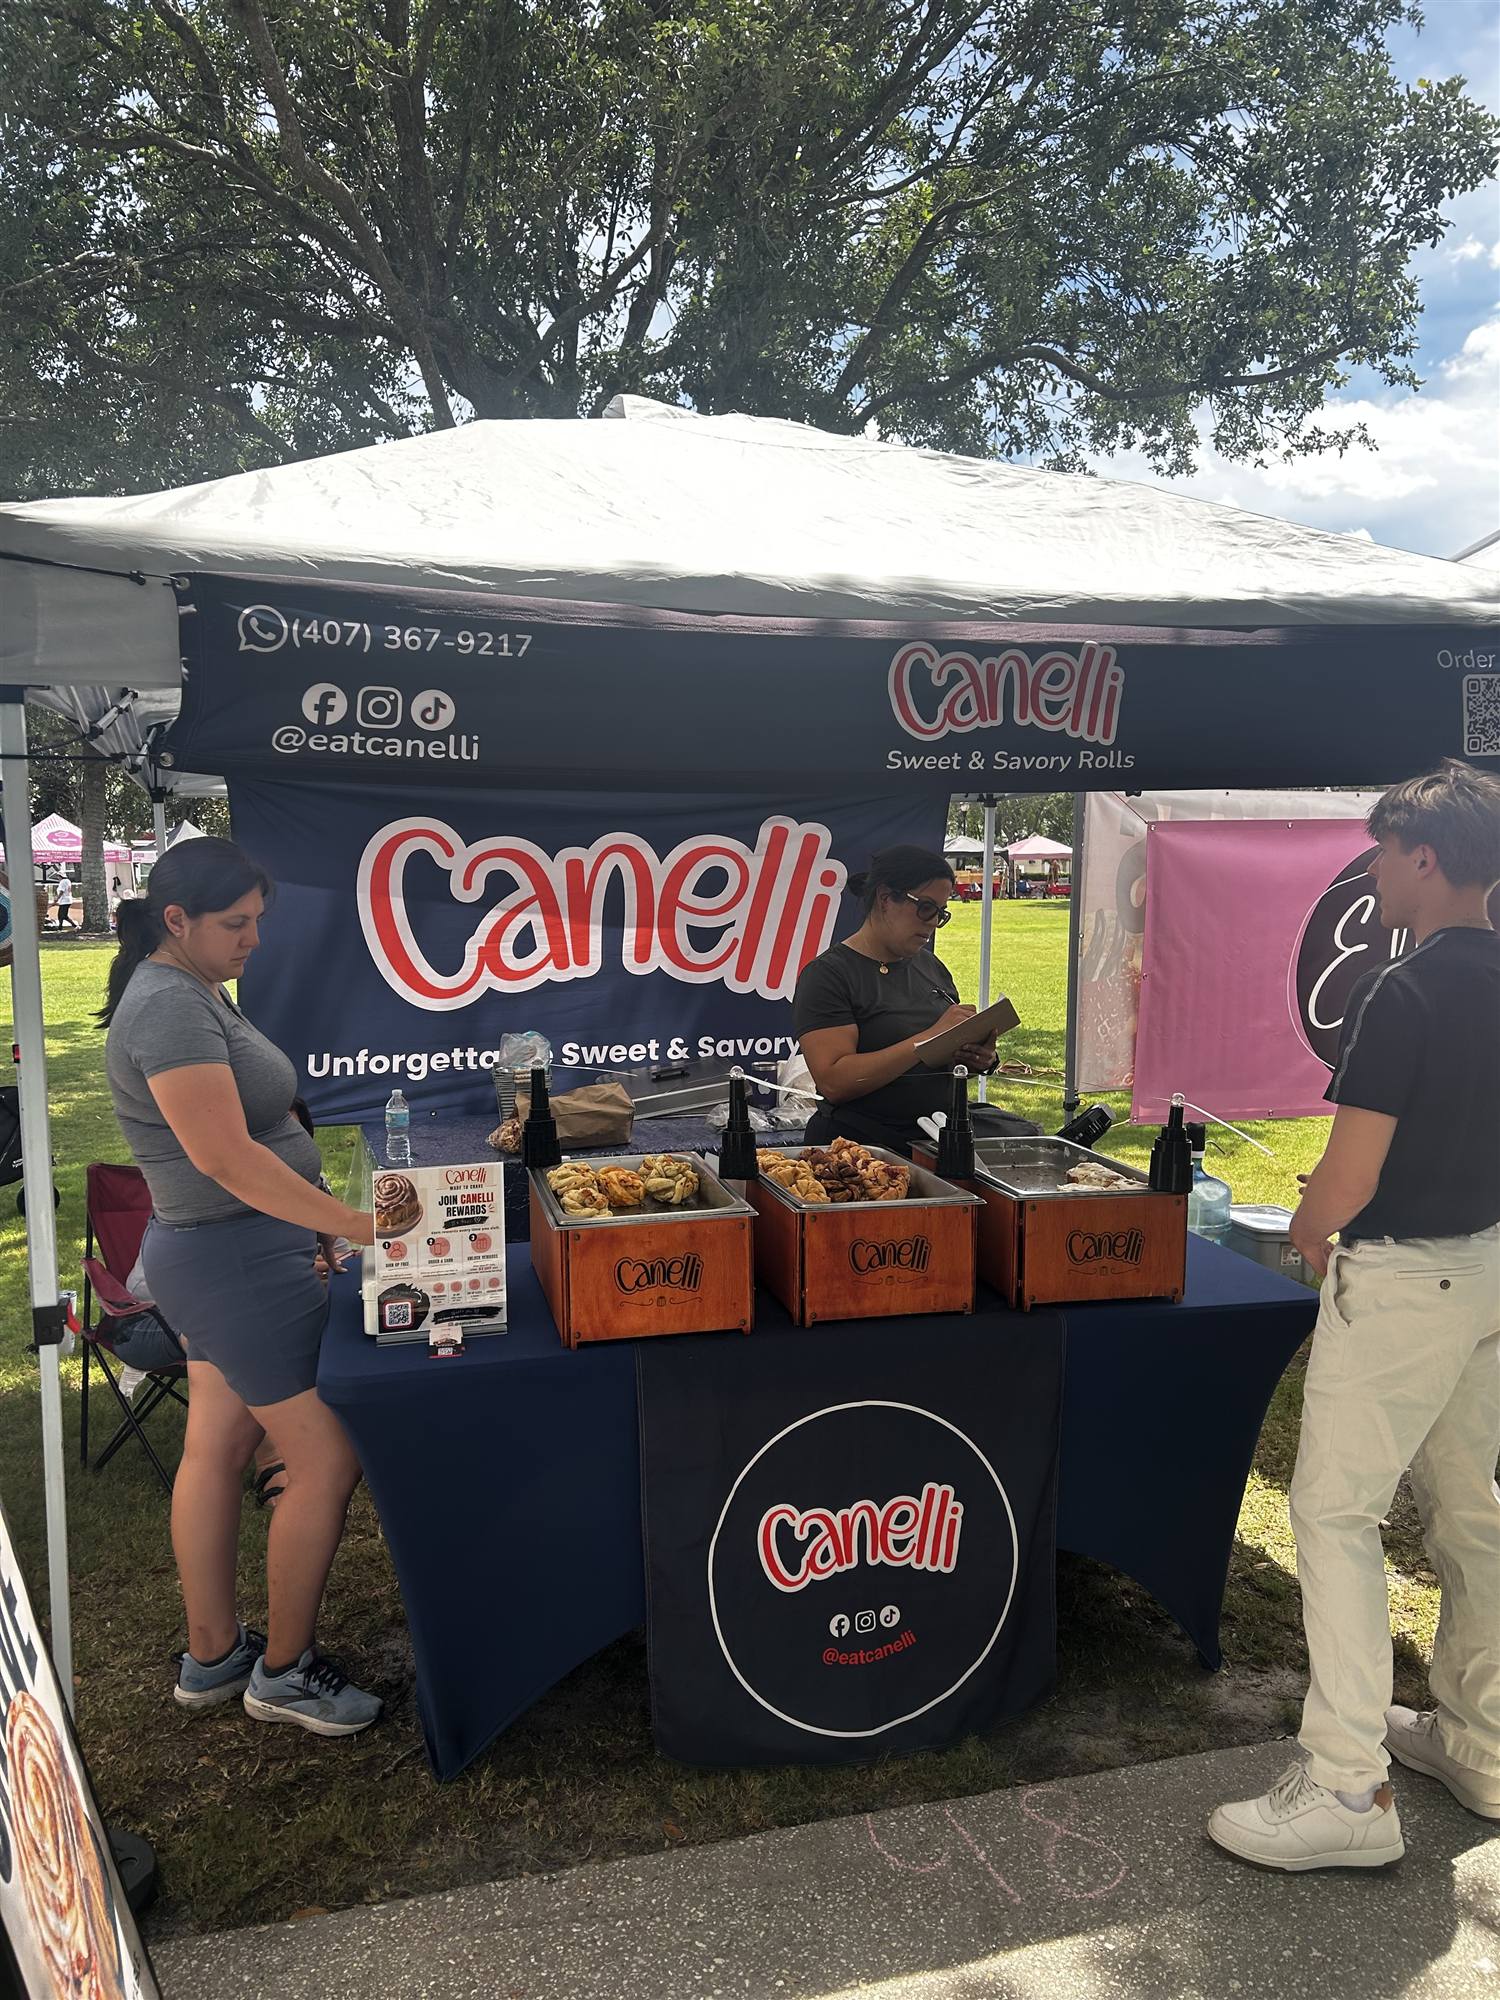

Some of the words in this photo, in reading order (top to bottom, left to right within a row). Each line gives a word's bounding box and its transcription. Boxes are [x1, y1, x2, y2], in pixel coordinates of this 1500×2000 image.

[292, 619, 372, 653] (407)
[384, 626, 533, 657] 367-9217
[1437, 649, 1496, 668] Order
[888, 641, 1126, 745] Canelli
[272, 725, 480, 761] @eatcanelli
[886, 750, 962, 769] Sweet
[968, 752, 985, 770] &
[993, 750, 1073, 772] Savory
[1078, 750, 1135, 769] Rolls
[357, 815, 848, 1011] Canelli
[307, 1047, 554, 1081] Unforgetta
[561, 1039, 660, 1065] Sweet
[666, 1037, 690, 1060] &
[445, 1168, 487, 1185] Canelli
[438, 1194, 458, 1206] JOIN
[460, 1192, 494, 1204] CANELLI
[446, 1204, 487, 1217] REWARDS
[848, 1234, 932, 1276] Canelli
[1066, 1228, 1145, 1265] Canelli
[614, 1252, 704, 1295] Canelli
[757, 1482, 964, 1593] Canelli
[822, 1630, 918, 1666] @eatcanelli
